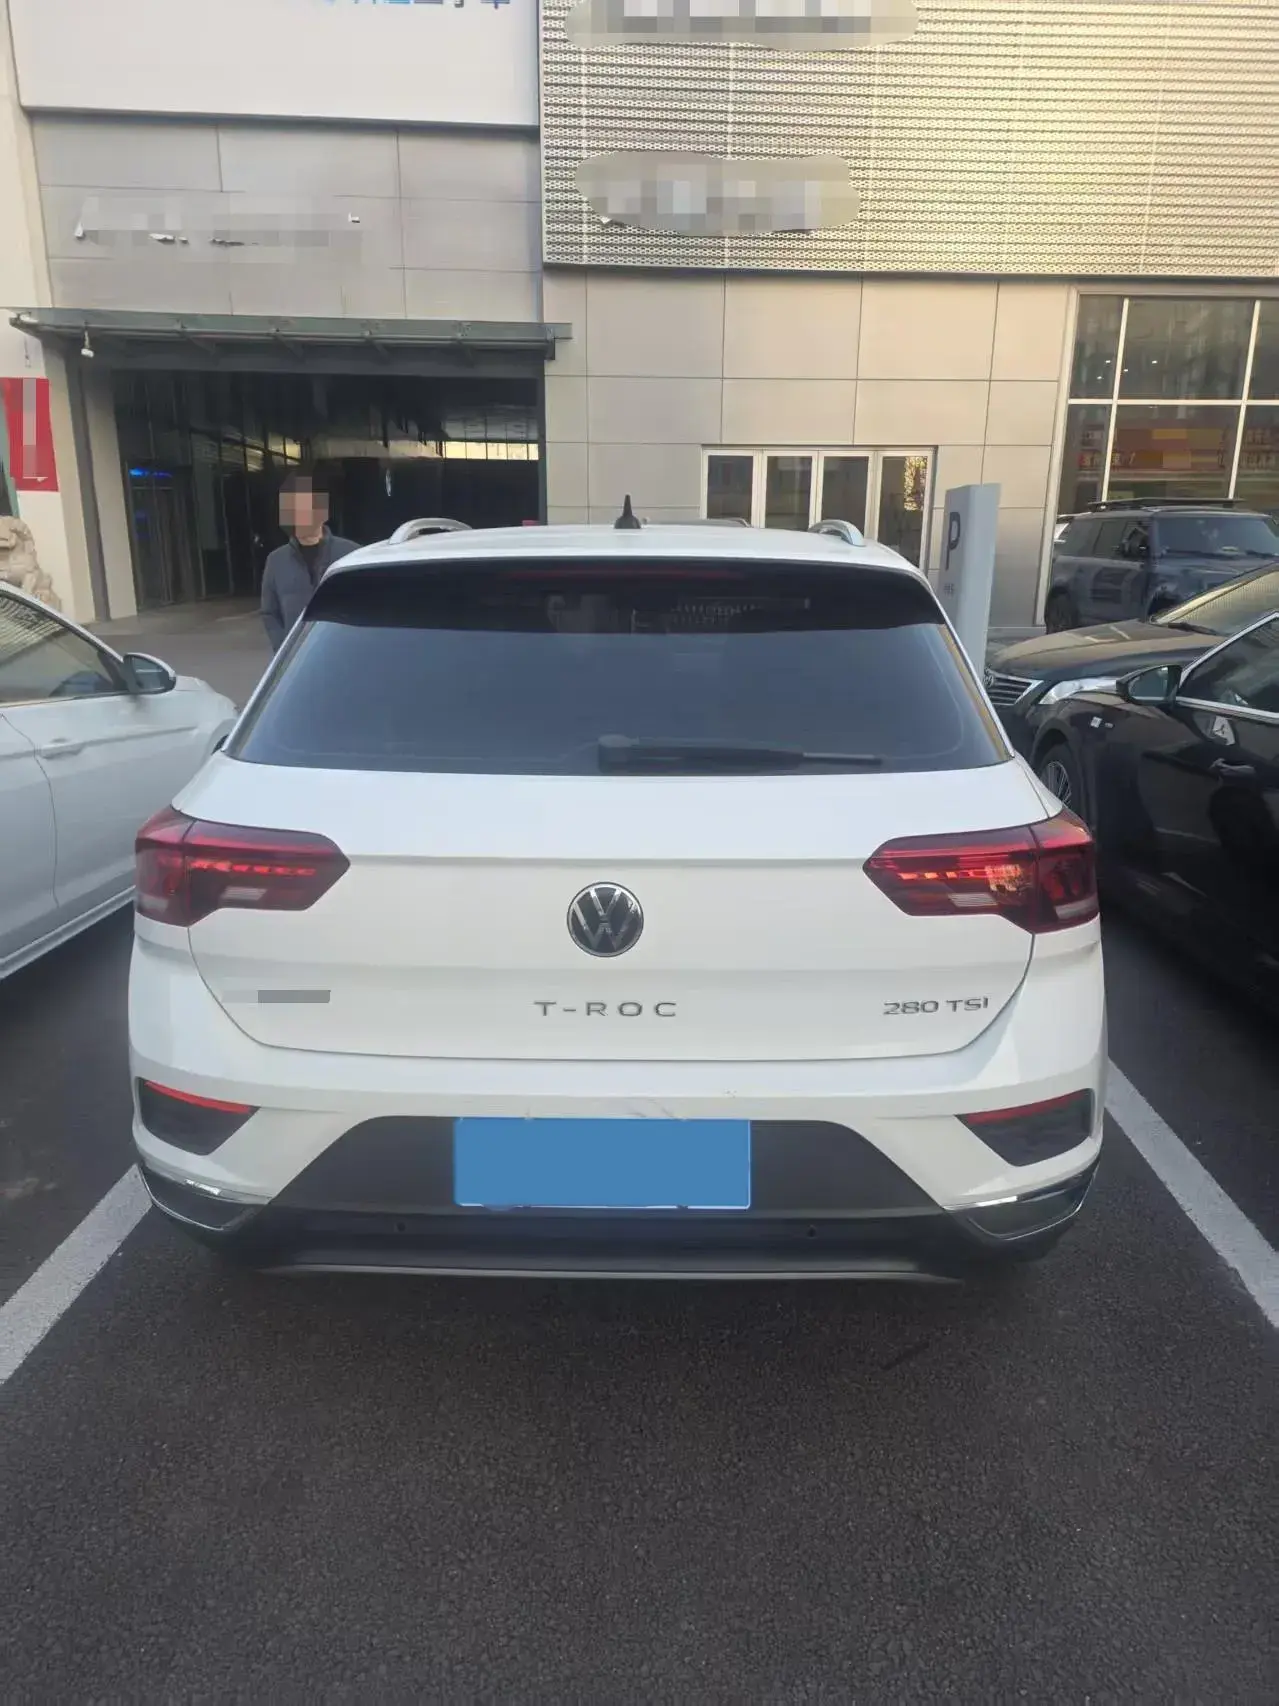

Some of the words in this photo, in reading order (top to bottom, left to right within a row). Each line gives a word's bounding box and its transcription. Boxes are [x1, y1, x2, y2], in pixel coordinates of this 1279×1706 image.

[945, 511, 961, 571] P
[534, 1001, 677, 1017] T-ROC
[883, 1000, 939, 1015] 280
[946, 997, 989, 1012] TSI
